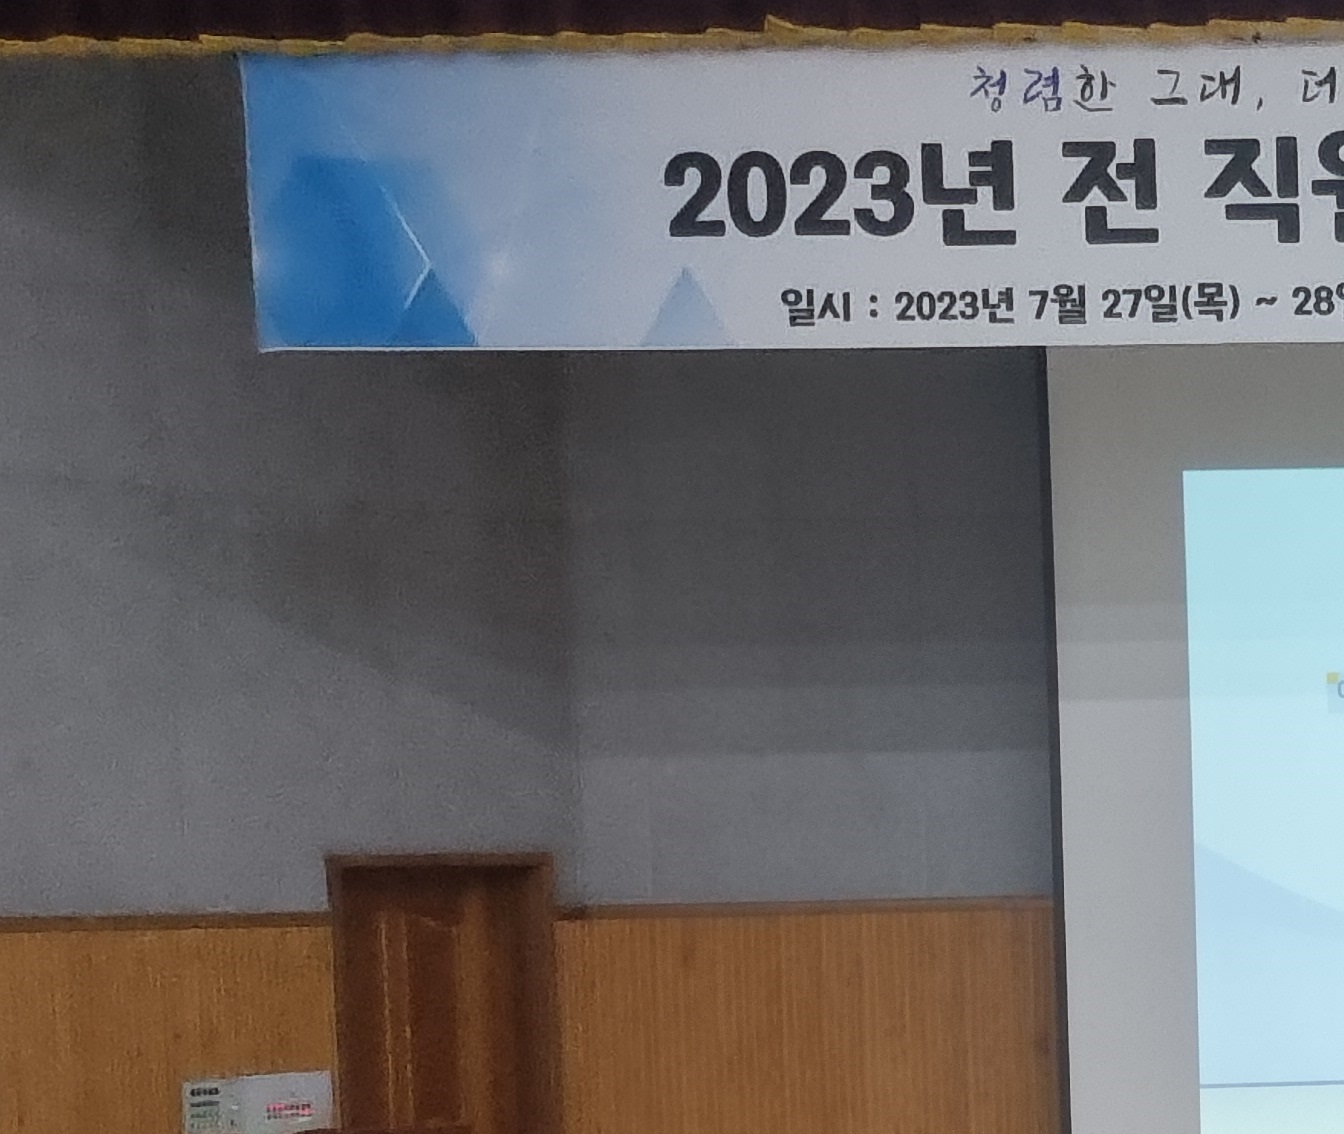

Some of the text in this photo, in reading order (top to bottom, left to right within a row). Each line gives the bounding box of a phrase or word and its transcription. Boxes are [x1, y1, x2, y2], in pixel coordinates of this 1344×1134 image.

[971, 66, 1116, 112] 청렴한
[1151, 68, 1188, 106] 그
[1200, 65, 1264, 111] 대,
[1301, 66, 1338, 104] 더
[663, 139, 1017, 246] 2023년
[1061, 137, 1160, 245] 전
[780, 287, 852, 327] 일시
[895, 288, 1015, 323] 2023년
[1028, 284, 1087, 324] 7월
[1102, 282, 1240, 323] 27일(목)
